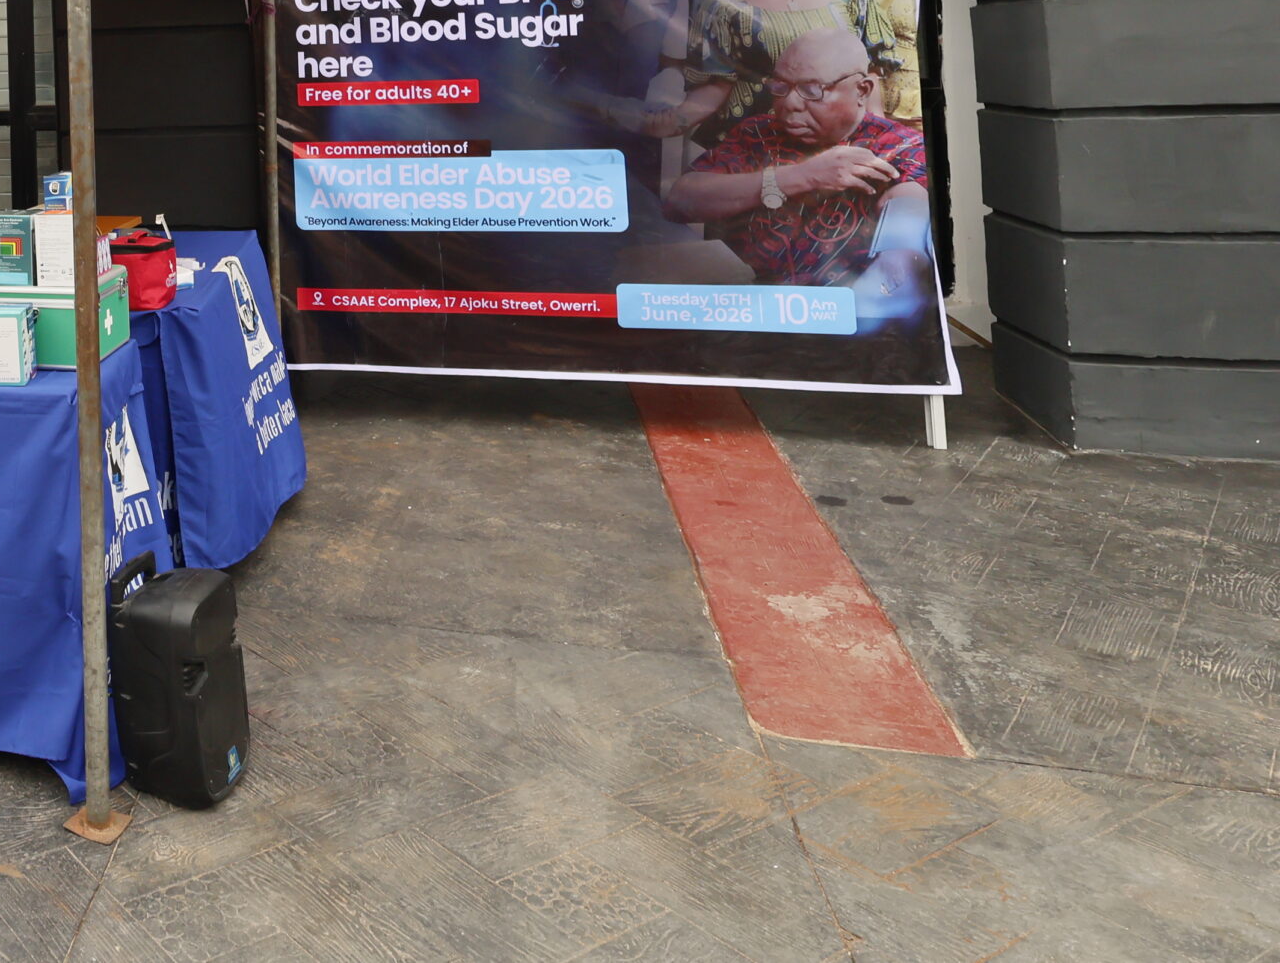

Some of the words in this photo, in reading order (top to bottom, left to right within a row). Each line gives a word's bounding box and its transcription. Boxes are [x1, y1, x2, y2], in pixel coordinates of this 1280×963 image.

[296, 18, 362, 46] and
[370, 12, 467, 43] Blood
[475, 12, 584, 48] Sugar
[297, 51, 373, 79] here
[305, 87, 343, 102] Free
[346, 86, 372, 101] for
[375, 85, 432, 100] adults
[436, 84, 472, 99] 40+
[306, 144, 319, 155] In
[324, 142, 450, 155] commemoration
[453, 141, 469, 155] of
[308, 163, 392, 187] World
[399, 163, 468, 186] Elder
[475, 162, 571, 186] Abuse
[309, 188, 468, 210] Awareness
[475, 187, 533, 217] Day
[540, 186, 614, 210] 2026
[348, 216, 410, 227] Awareness:
[410, 217, 451, 229] Making
[452, 217, 480, 228] Elder
[480, 217, 517, 228] Abuse
[517, 217, 578, 228] Prevention
[332, 295, 376, 307] CSAAE
[377, 296, 442, 311] Complex,
[444, 297, 456, 308] 17
[459, 297, 498, 311] Ajoku
[501, 298, 546, 312] Street,
[549, 299, 601, 313] Owerri.
[641, 292, 709, 309] Tuesday
[713, 293, 751, 306] 16TH
[774, 293, 809, 325] 10
[810, 299, 837, 311] Am
[640, 307, 697, 324] June,
[702, 308, 753, 324] 2026
[810, 311, 838, 322] WAT
